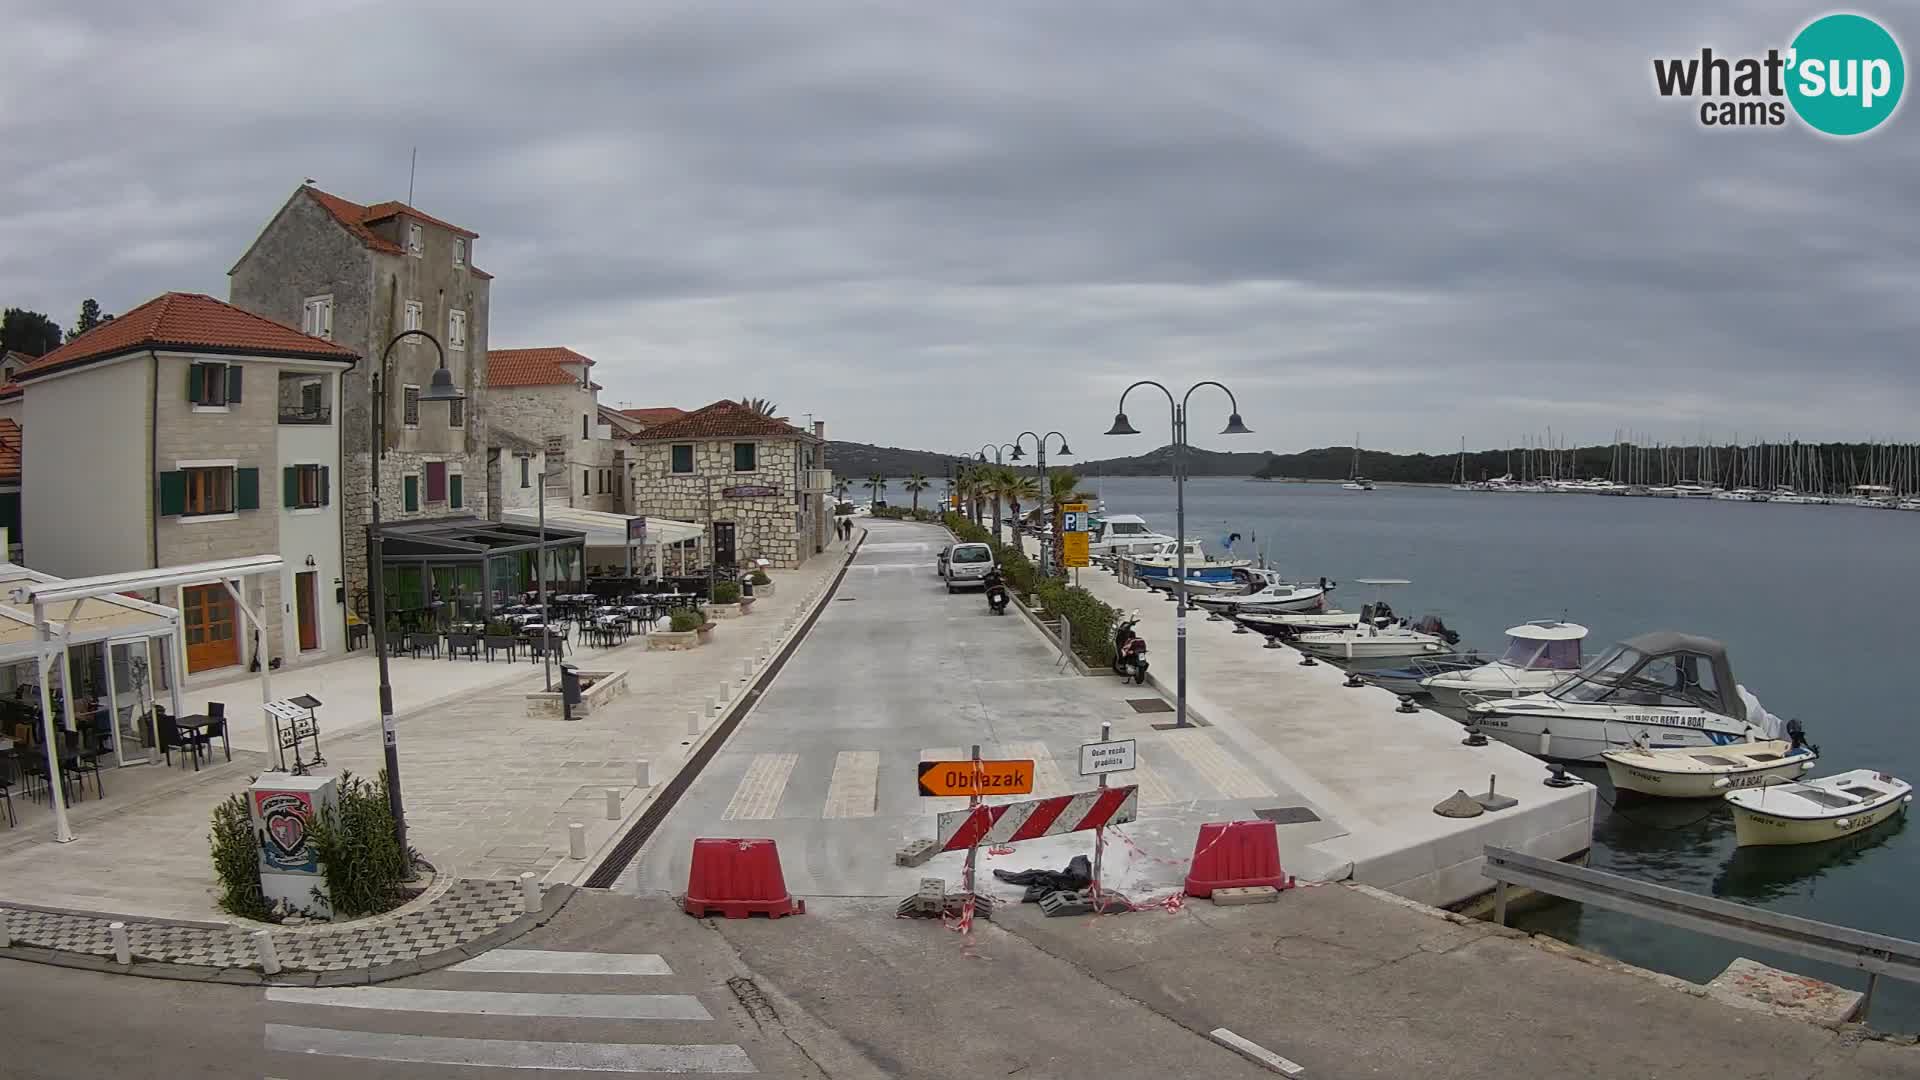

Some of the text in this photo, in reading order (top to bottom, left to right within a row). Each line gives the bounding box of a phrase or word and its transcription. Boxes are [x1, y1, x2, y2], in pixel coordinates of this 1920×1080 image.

[1065, 513, 1076, 530] P
[1660, 715, 1680, 725] RENT
[1686, 716, 1706, 729] BOAT
[945, 769, 1024, 788] Obilazak
